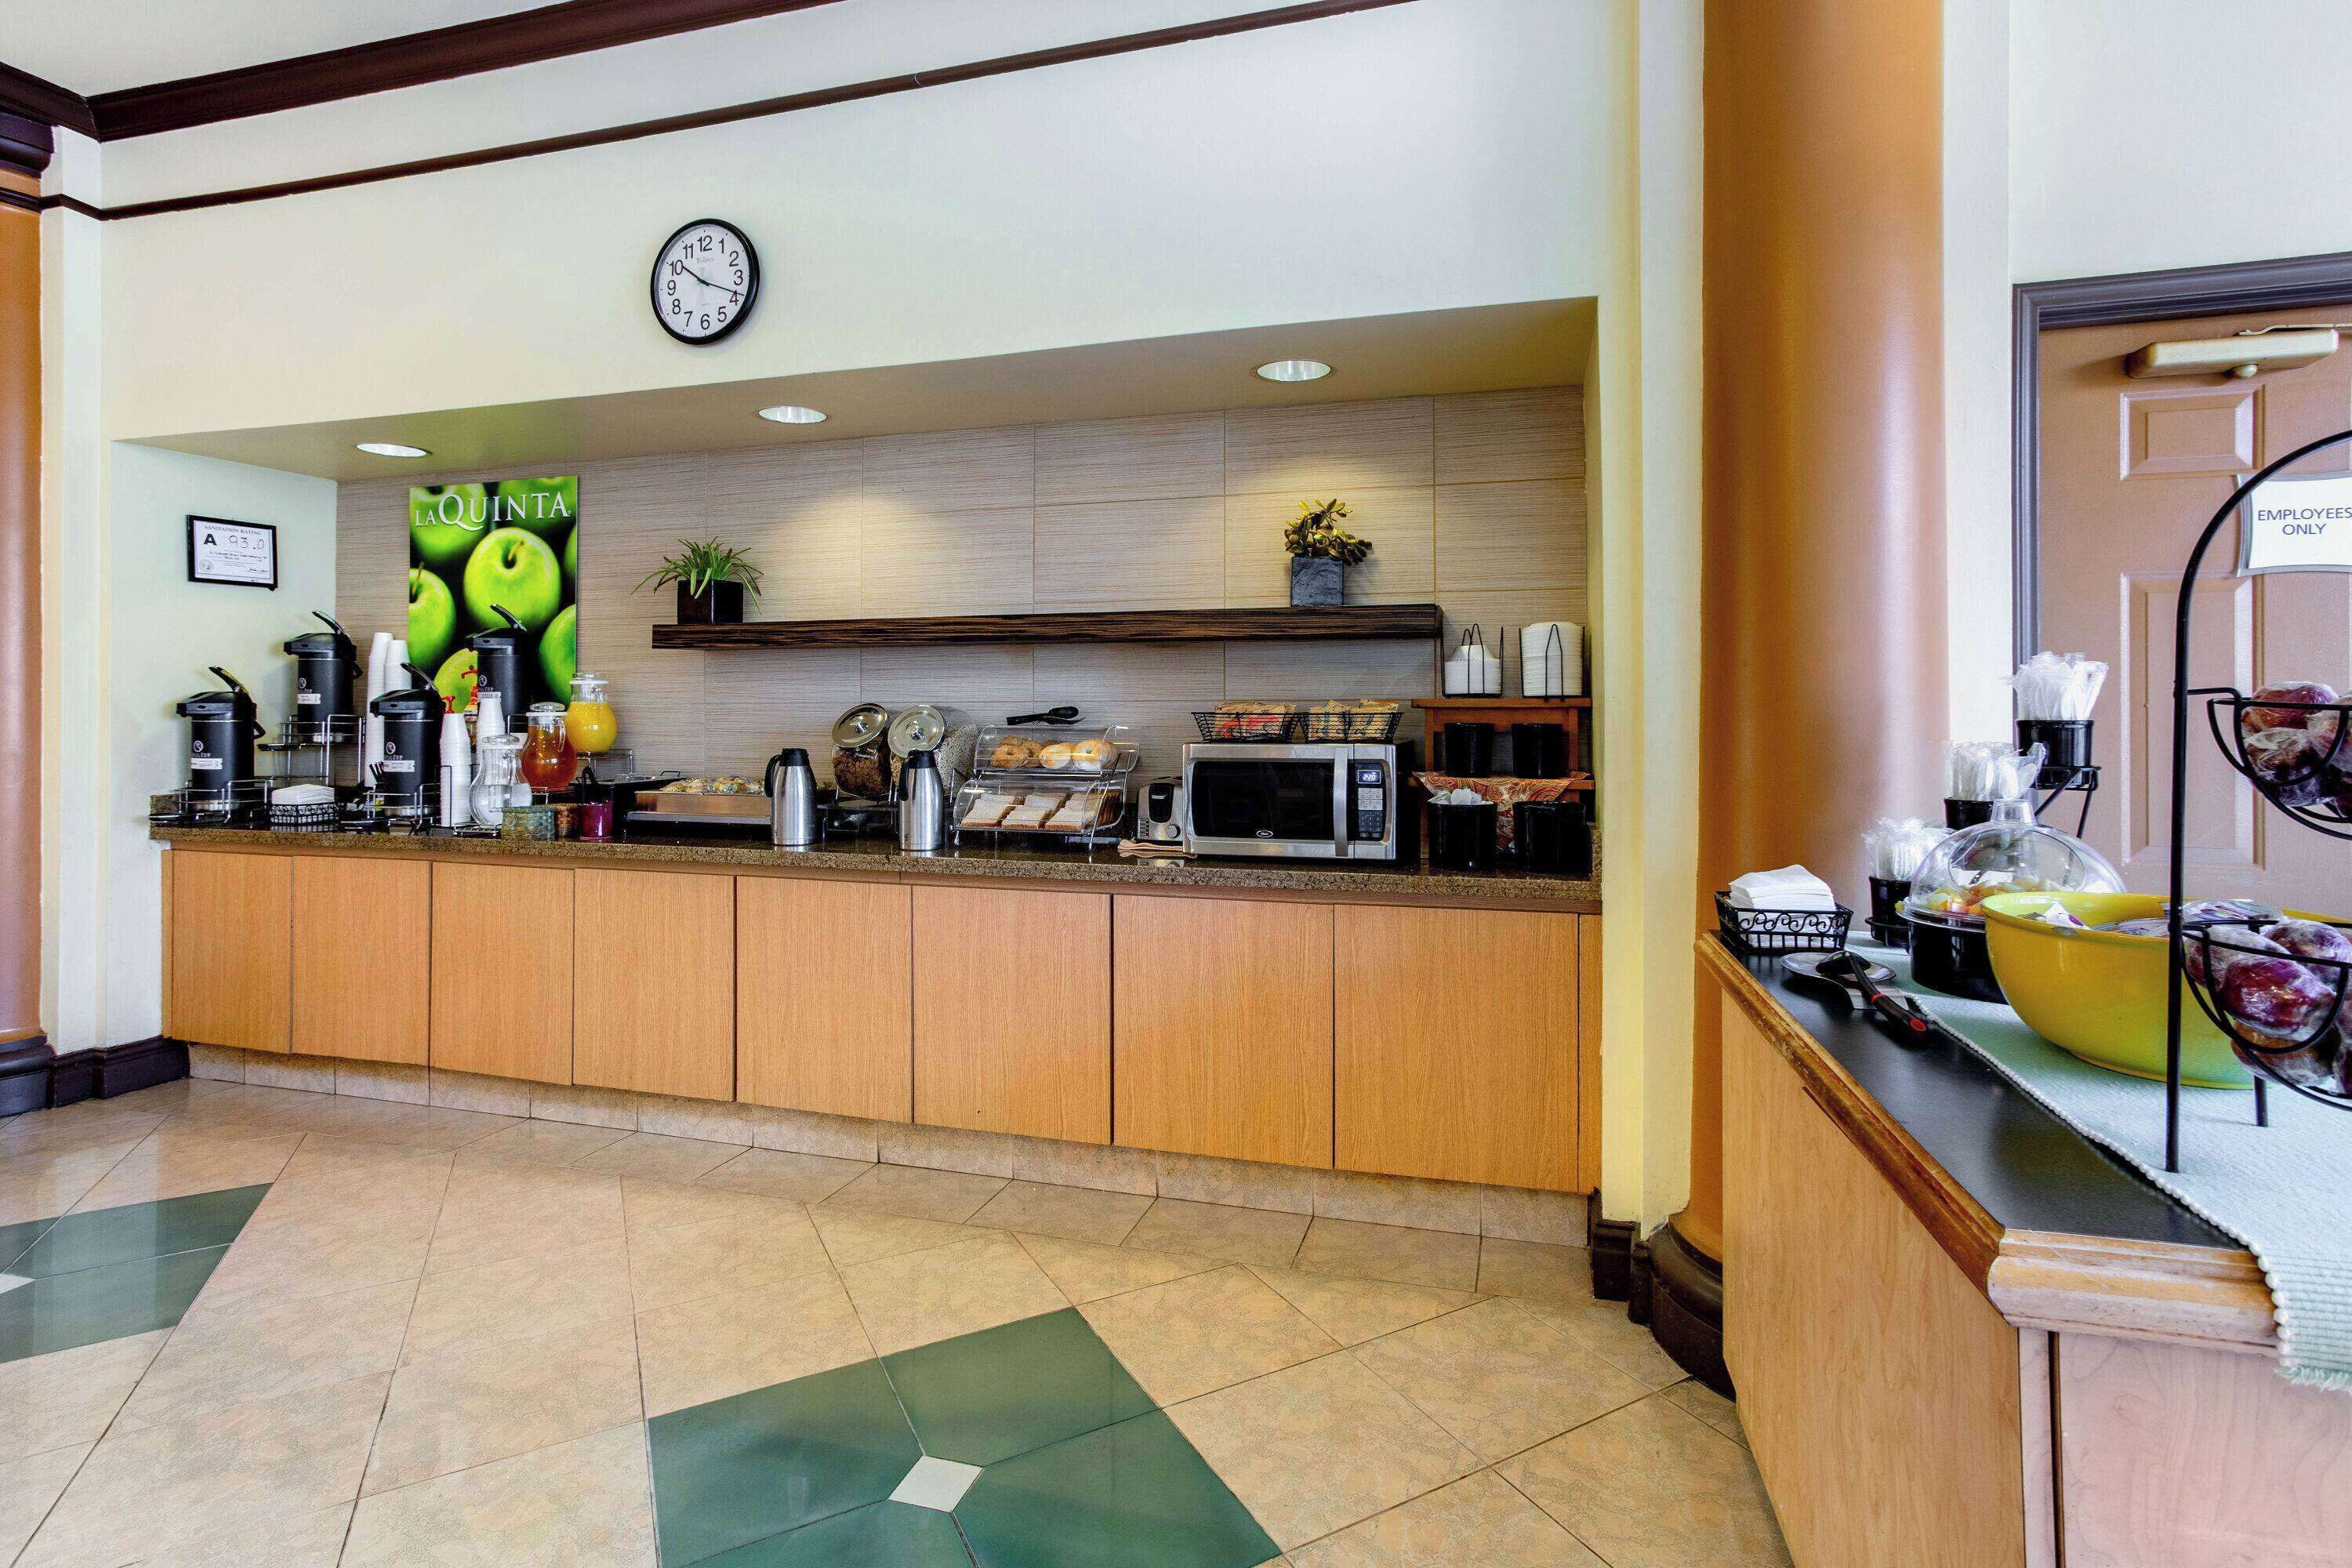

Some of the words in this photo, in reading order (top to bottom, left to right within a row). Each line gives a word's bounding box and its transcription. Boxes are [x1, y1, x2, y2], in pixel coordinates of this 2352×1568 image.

[683, 243, 694, 260] 11
[697, 235, 712, 252] 12
[719, 238, 724, 254] 1
[728, 250, 739, 267] 2
[670, 260, 684, 276] 10
[733, 269, 743, 286] 3
[667, 279, 677, 296] 9
[729, 289, 739, 306] 4
[672, 298, 681, 314] 8
[717, 306, 727, 322] 5
[684, 310, 694, 327] 7
[700, 314, 710, 329] 6
[2258, 506, 2352, 521] EMPLOYEES
[204, 524, 239, 533] SANITATION
[2282, 523, 2327, 535] ONLY
[203, 533, 217, 546] A
[229, 535, 264, 550] 93.0
